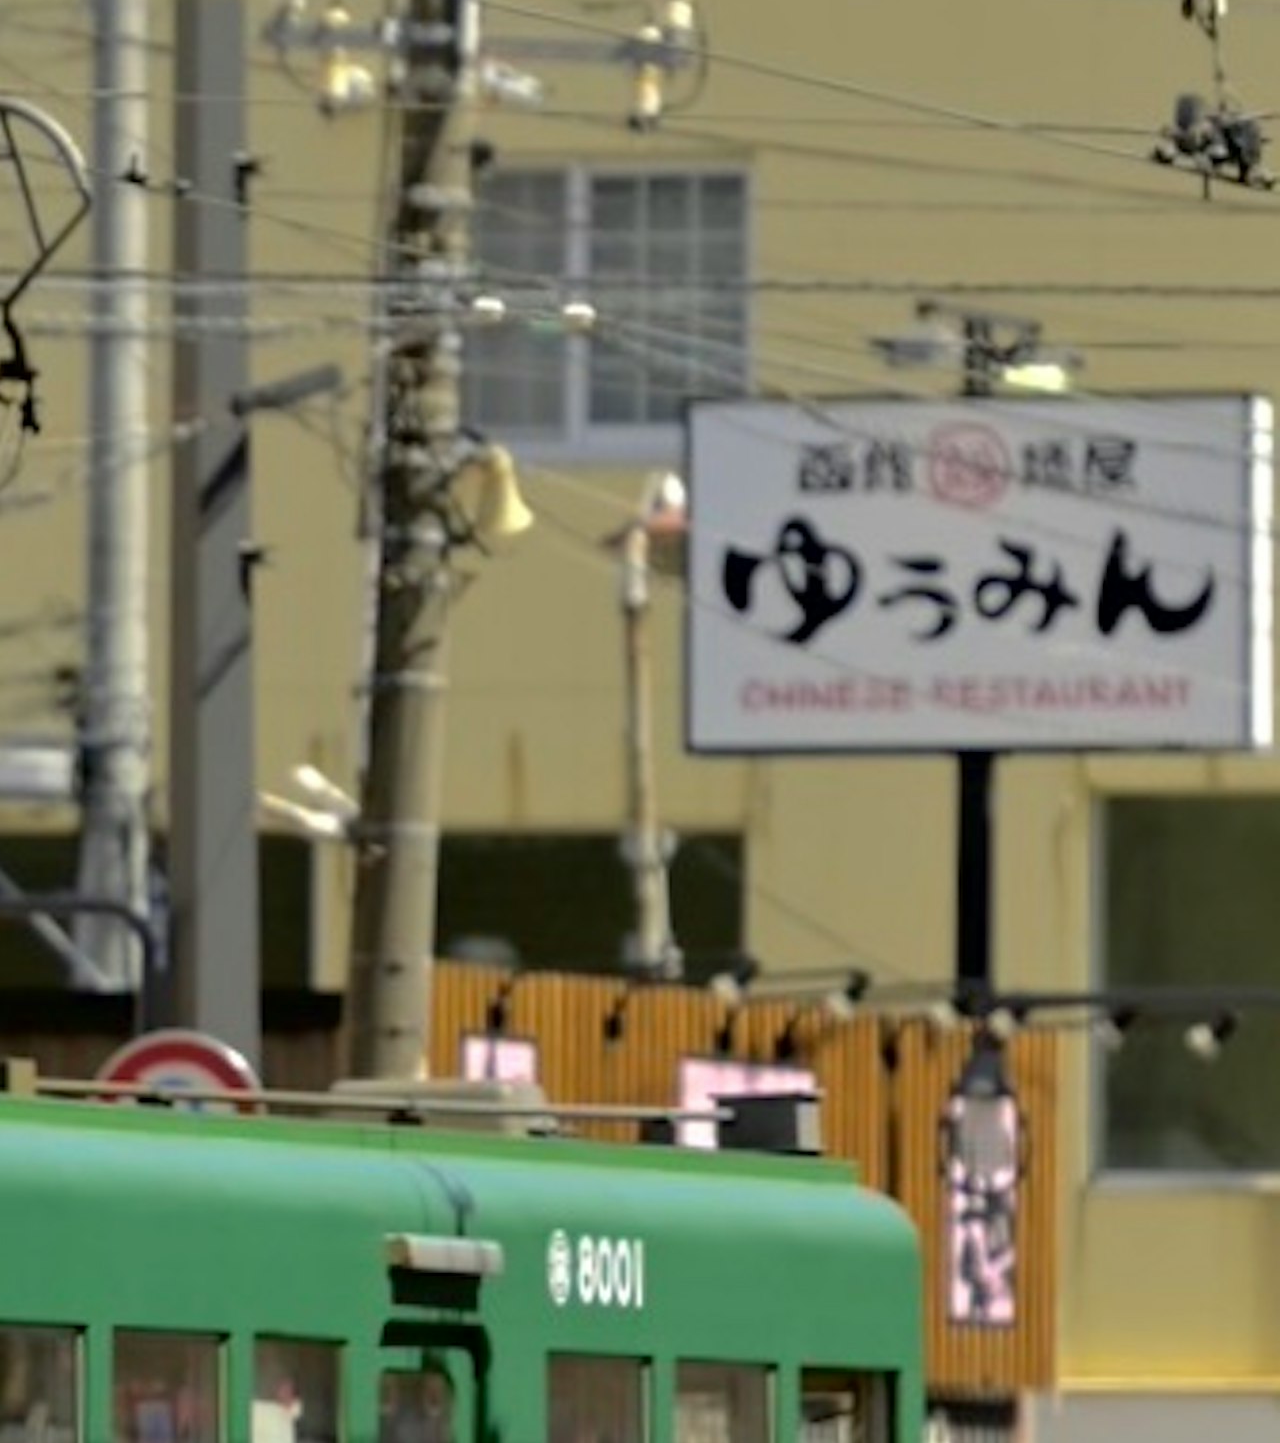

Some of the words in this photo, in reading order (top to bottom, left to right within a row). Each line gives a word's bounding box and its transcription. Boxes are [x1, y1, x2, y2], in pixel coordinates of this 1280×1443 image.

[722, 514, 1214, 644] ゆうみん
[740, 677, 914, 713] CHINESE
[937, 677, 1194, 711] RESTAURANT
[576, 1236, 644, 1308] 8001
